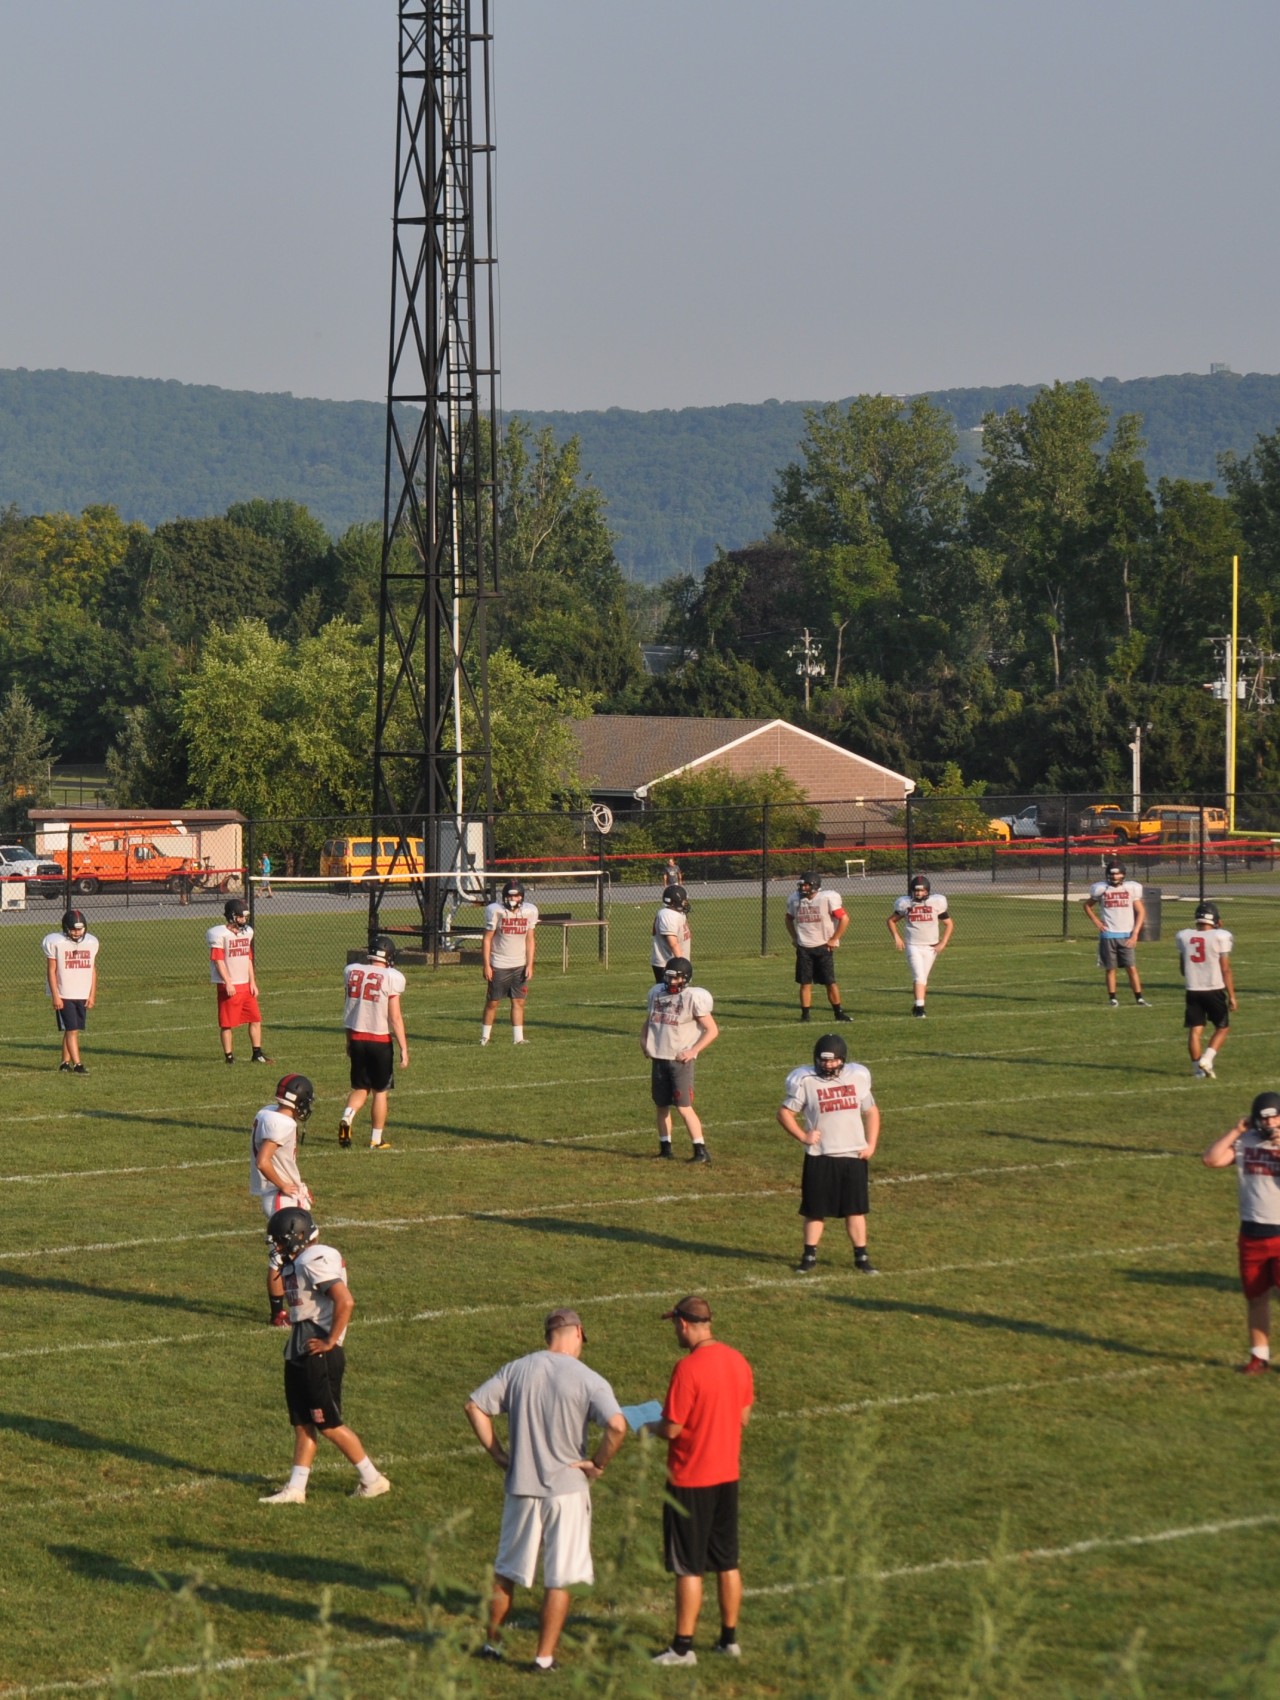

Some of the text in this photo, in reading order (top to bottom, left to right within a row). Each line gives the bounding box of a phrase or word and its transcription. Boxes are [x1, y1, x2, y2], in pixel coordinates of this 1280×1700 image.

[1189, 936, 1206, 963] 3
[348, 970, 385, 1003] 82
[816, 1085, 857, 1101] PANTHER
[819, 1097, 859, 1114] FOOTBALL
